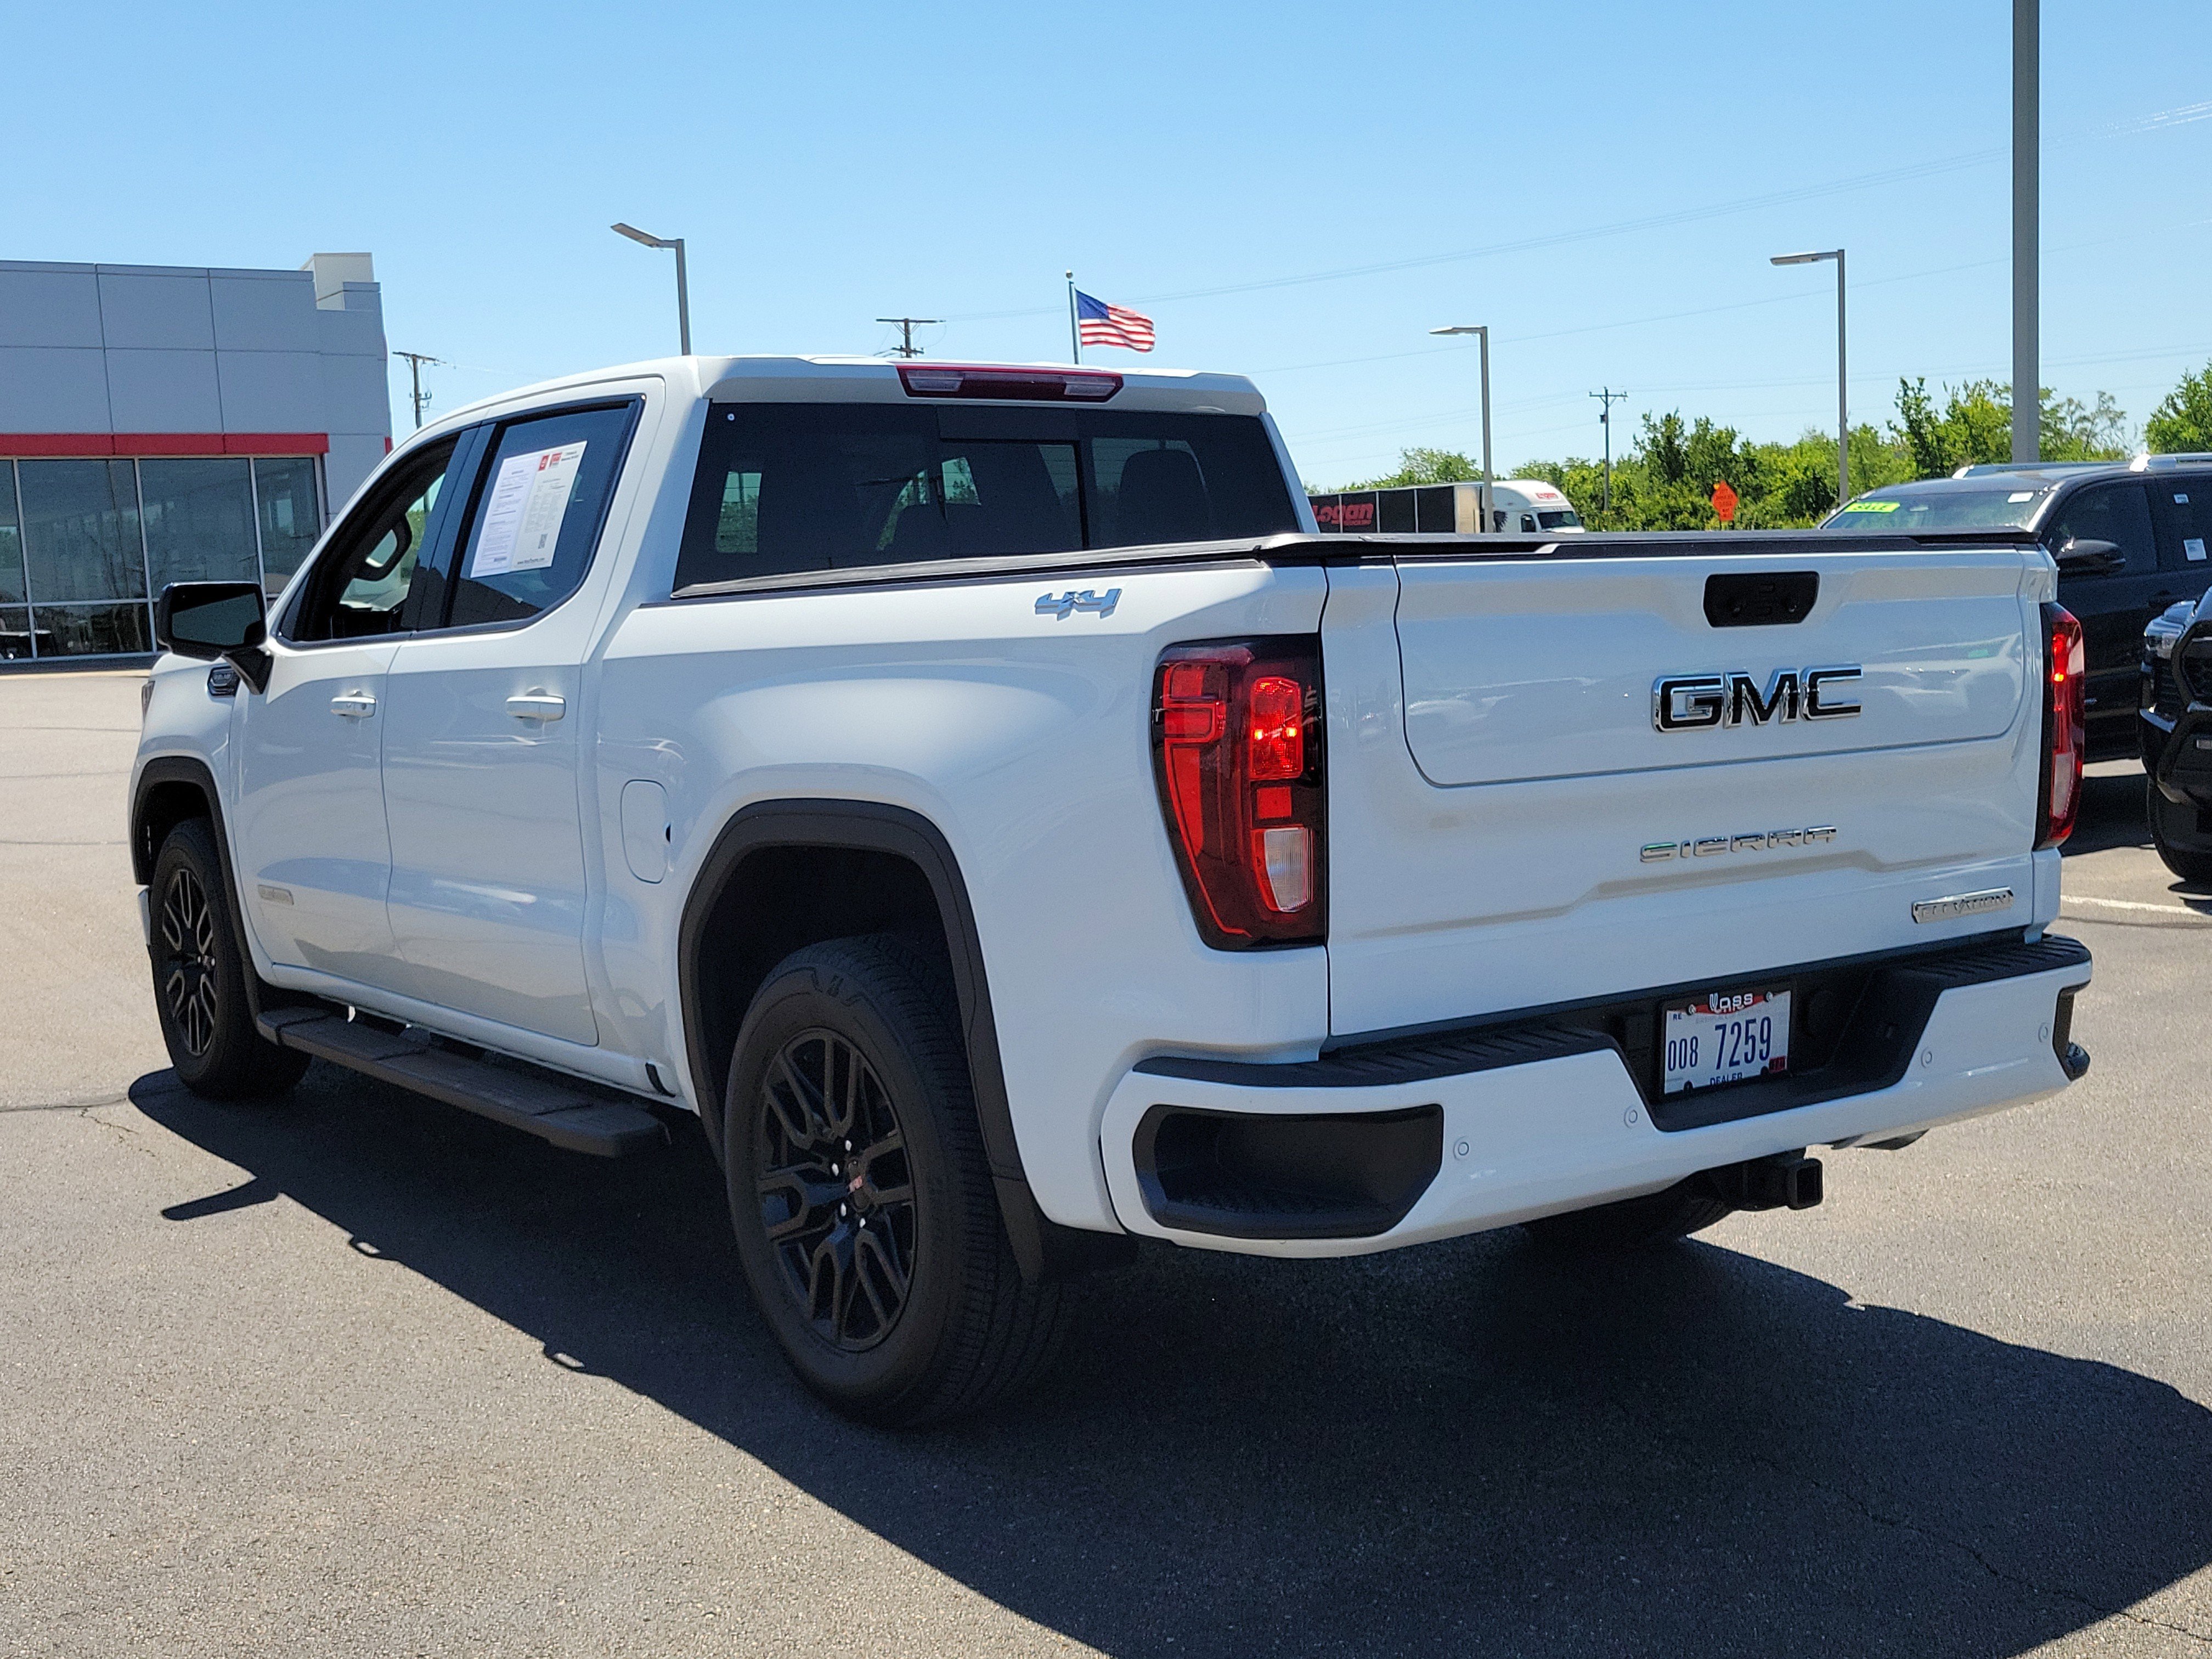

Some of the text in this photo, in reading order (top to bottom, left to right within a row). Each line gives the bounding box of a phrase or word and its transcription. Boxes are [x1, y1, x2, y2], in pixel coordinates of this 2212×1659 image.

[1651, 663, 1864, 732] GMC
[1640, 825, 1838, 863] SIERRA
[1668, 1016, 1771, 1071] 008 7259
